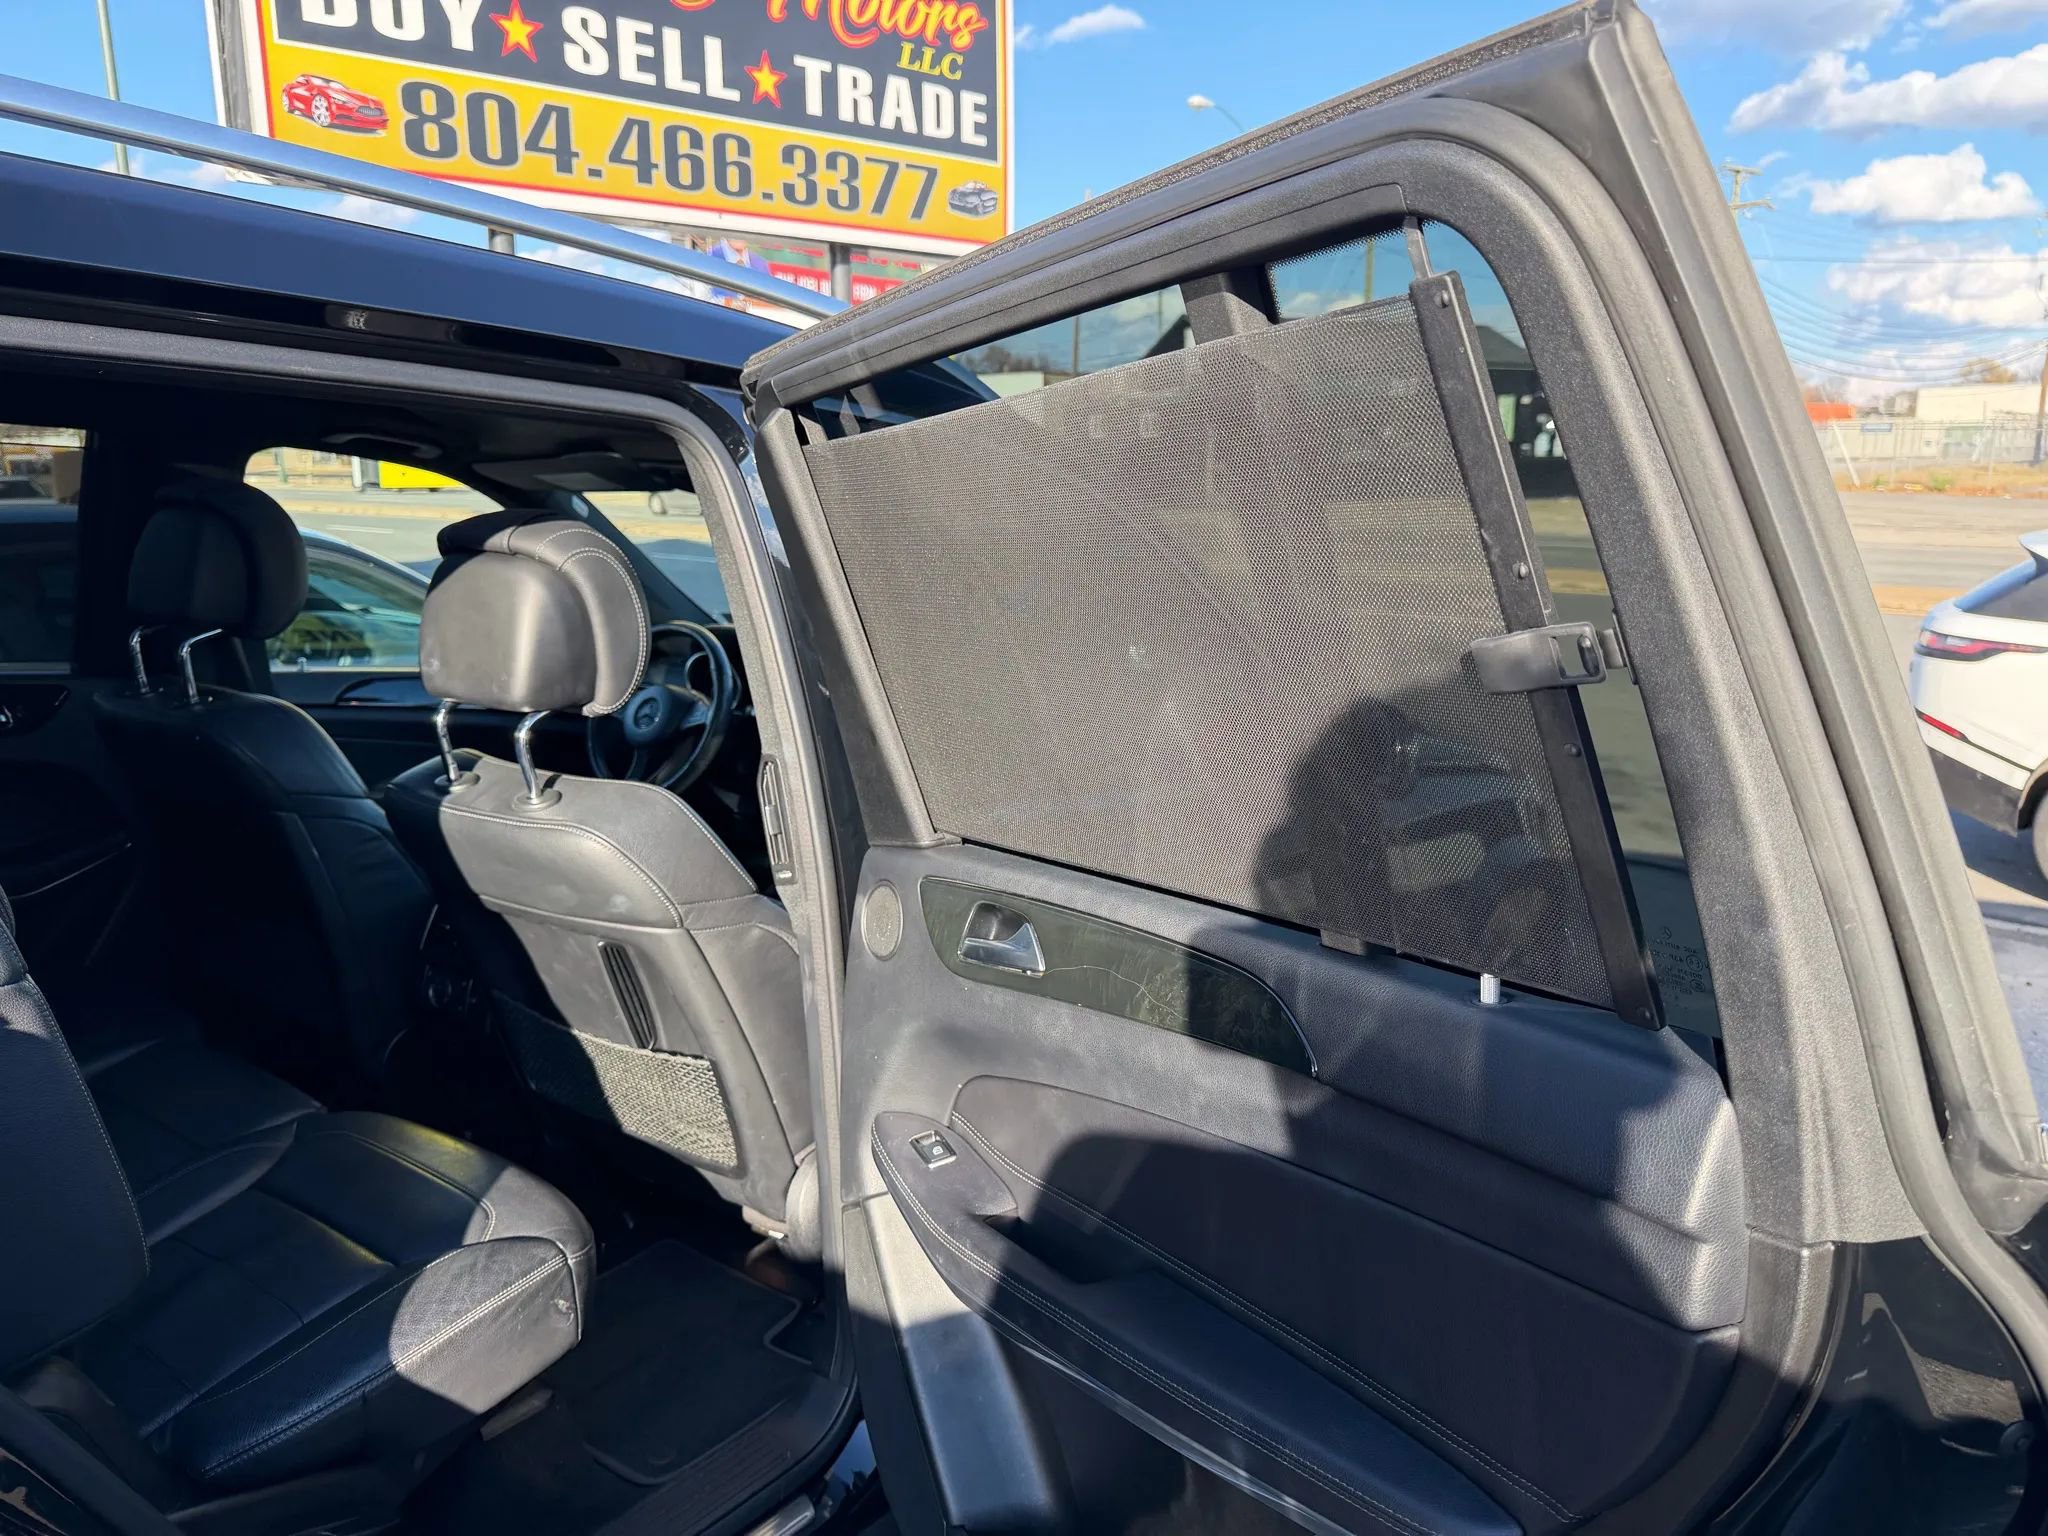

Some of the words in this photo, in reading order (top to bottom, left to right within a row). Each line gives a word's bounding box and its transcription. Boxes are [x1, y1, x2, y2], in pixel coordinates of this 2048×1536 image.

[561, 6, 741, 103] SELL
[793, 54, 988, 147] TRADE
[897, 41, 964, 81] LLC
[400, 81, 938, 220] 804.466.3377
